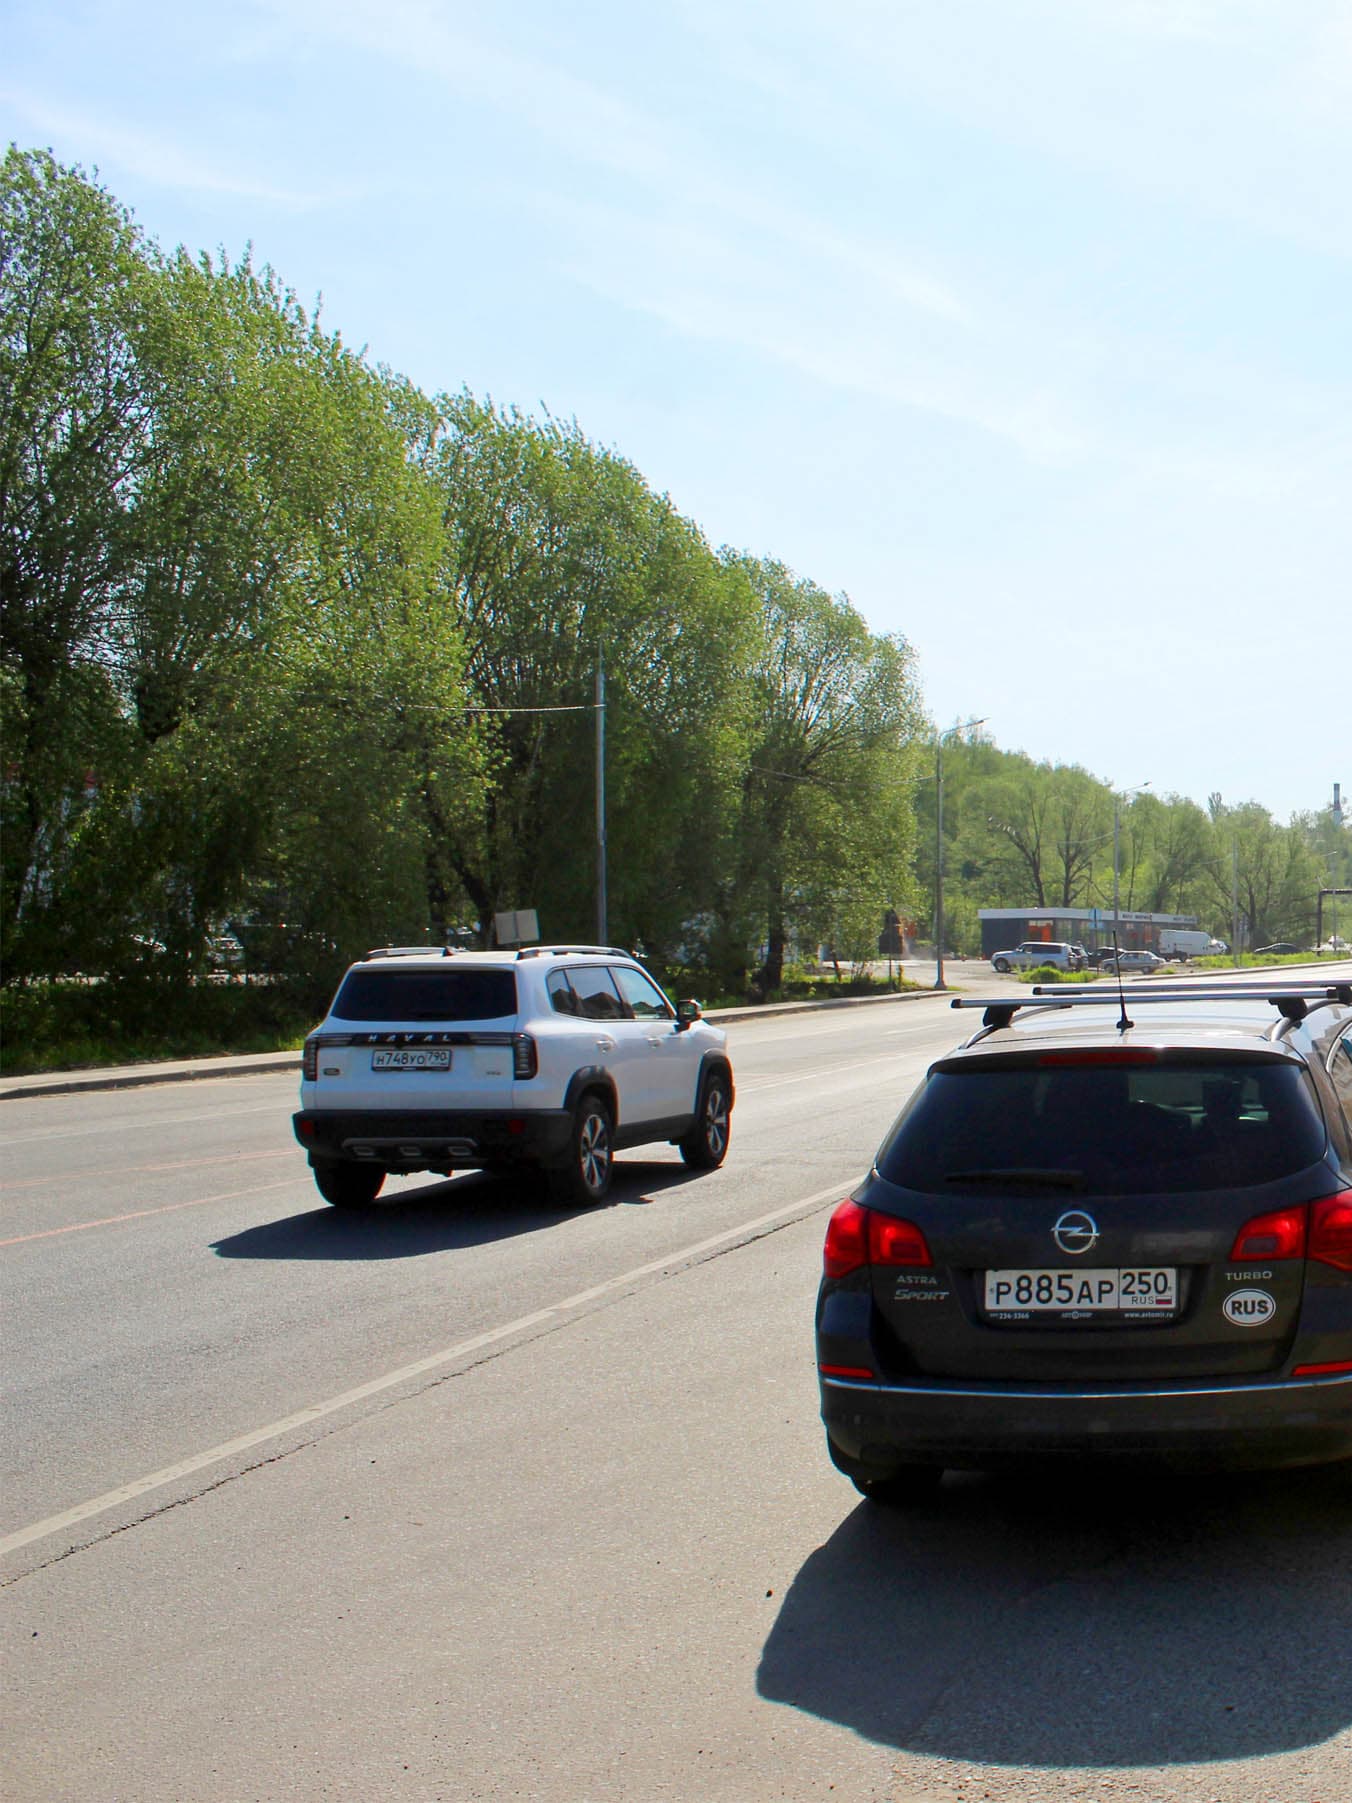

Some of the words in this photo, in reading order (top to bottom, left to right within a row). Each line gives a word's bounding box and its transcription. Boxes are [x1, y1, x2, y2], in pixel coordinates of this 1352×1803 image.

[367, 1034, 450, 1042] HAVAL
[896, 1275, 938, 1285] ASTRA
[1224, 1270, 1273, 1281] TURBO
[995, 1274, 1114, 1305] Р885АР
[1122, 1272, 1168, 1295] 250
[1131, 1296, 1155, 1305] RUS
[1231, 1299, 1269, 1315] RUS
